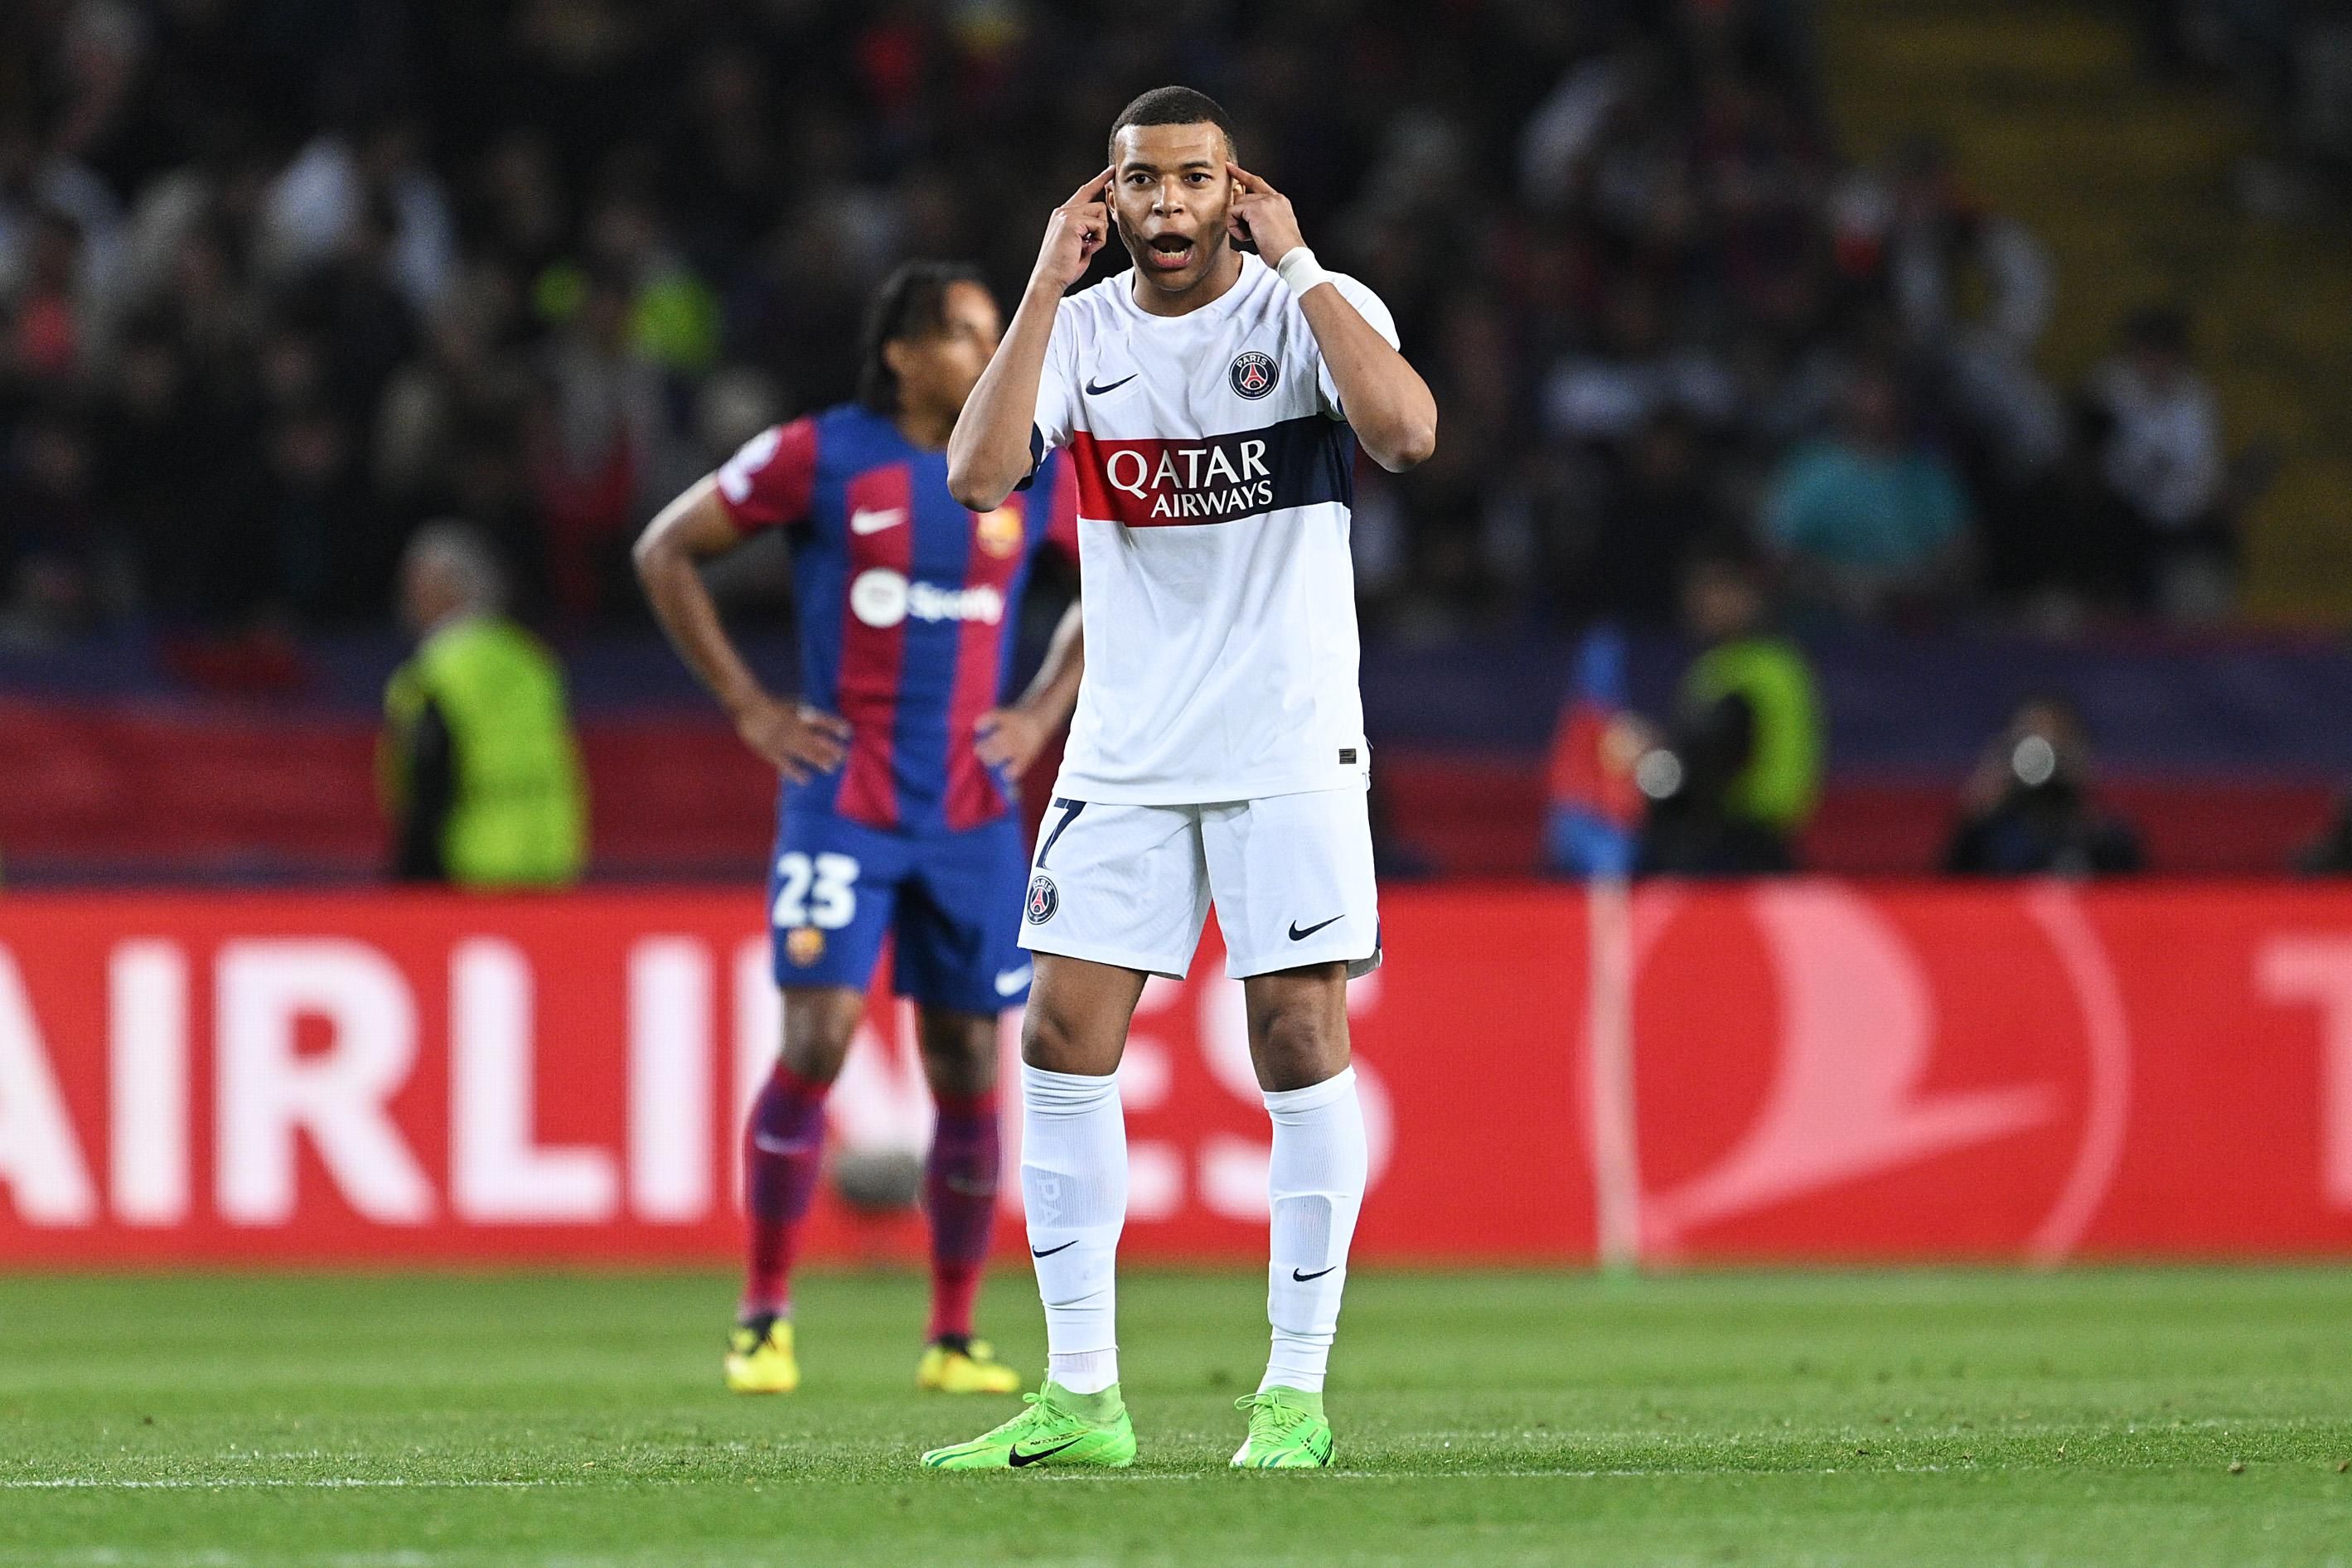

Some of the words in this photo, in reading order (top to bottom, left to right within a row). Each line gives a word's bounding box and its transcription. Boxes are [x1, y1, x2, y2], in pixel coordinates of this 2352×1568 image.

[1236, 355, 1267, 368] PARIS
[1106, 439, 1270, 500] QATAR
[1150, 480, 1273, 518] AIRWAYS
[1036, 797, 1087, 870] 7
[772, 850, 862, 929] 23
[1032, 879, 1053, 893] PARIS
